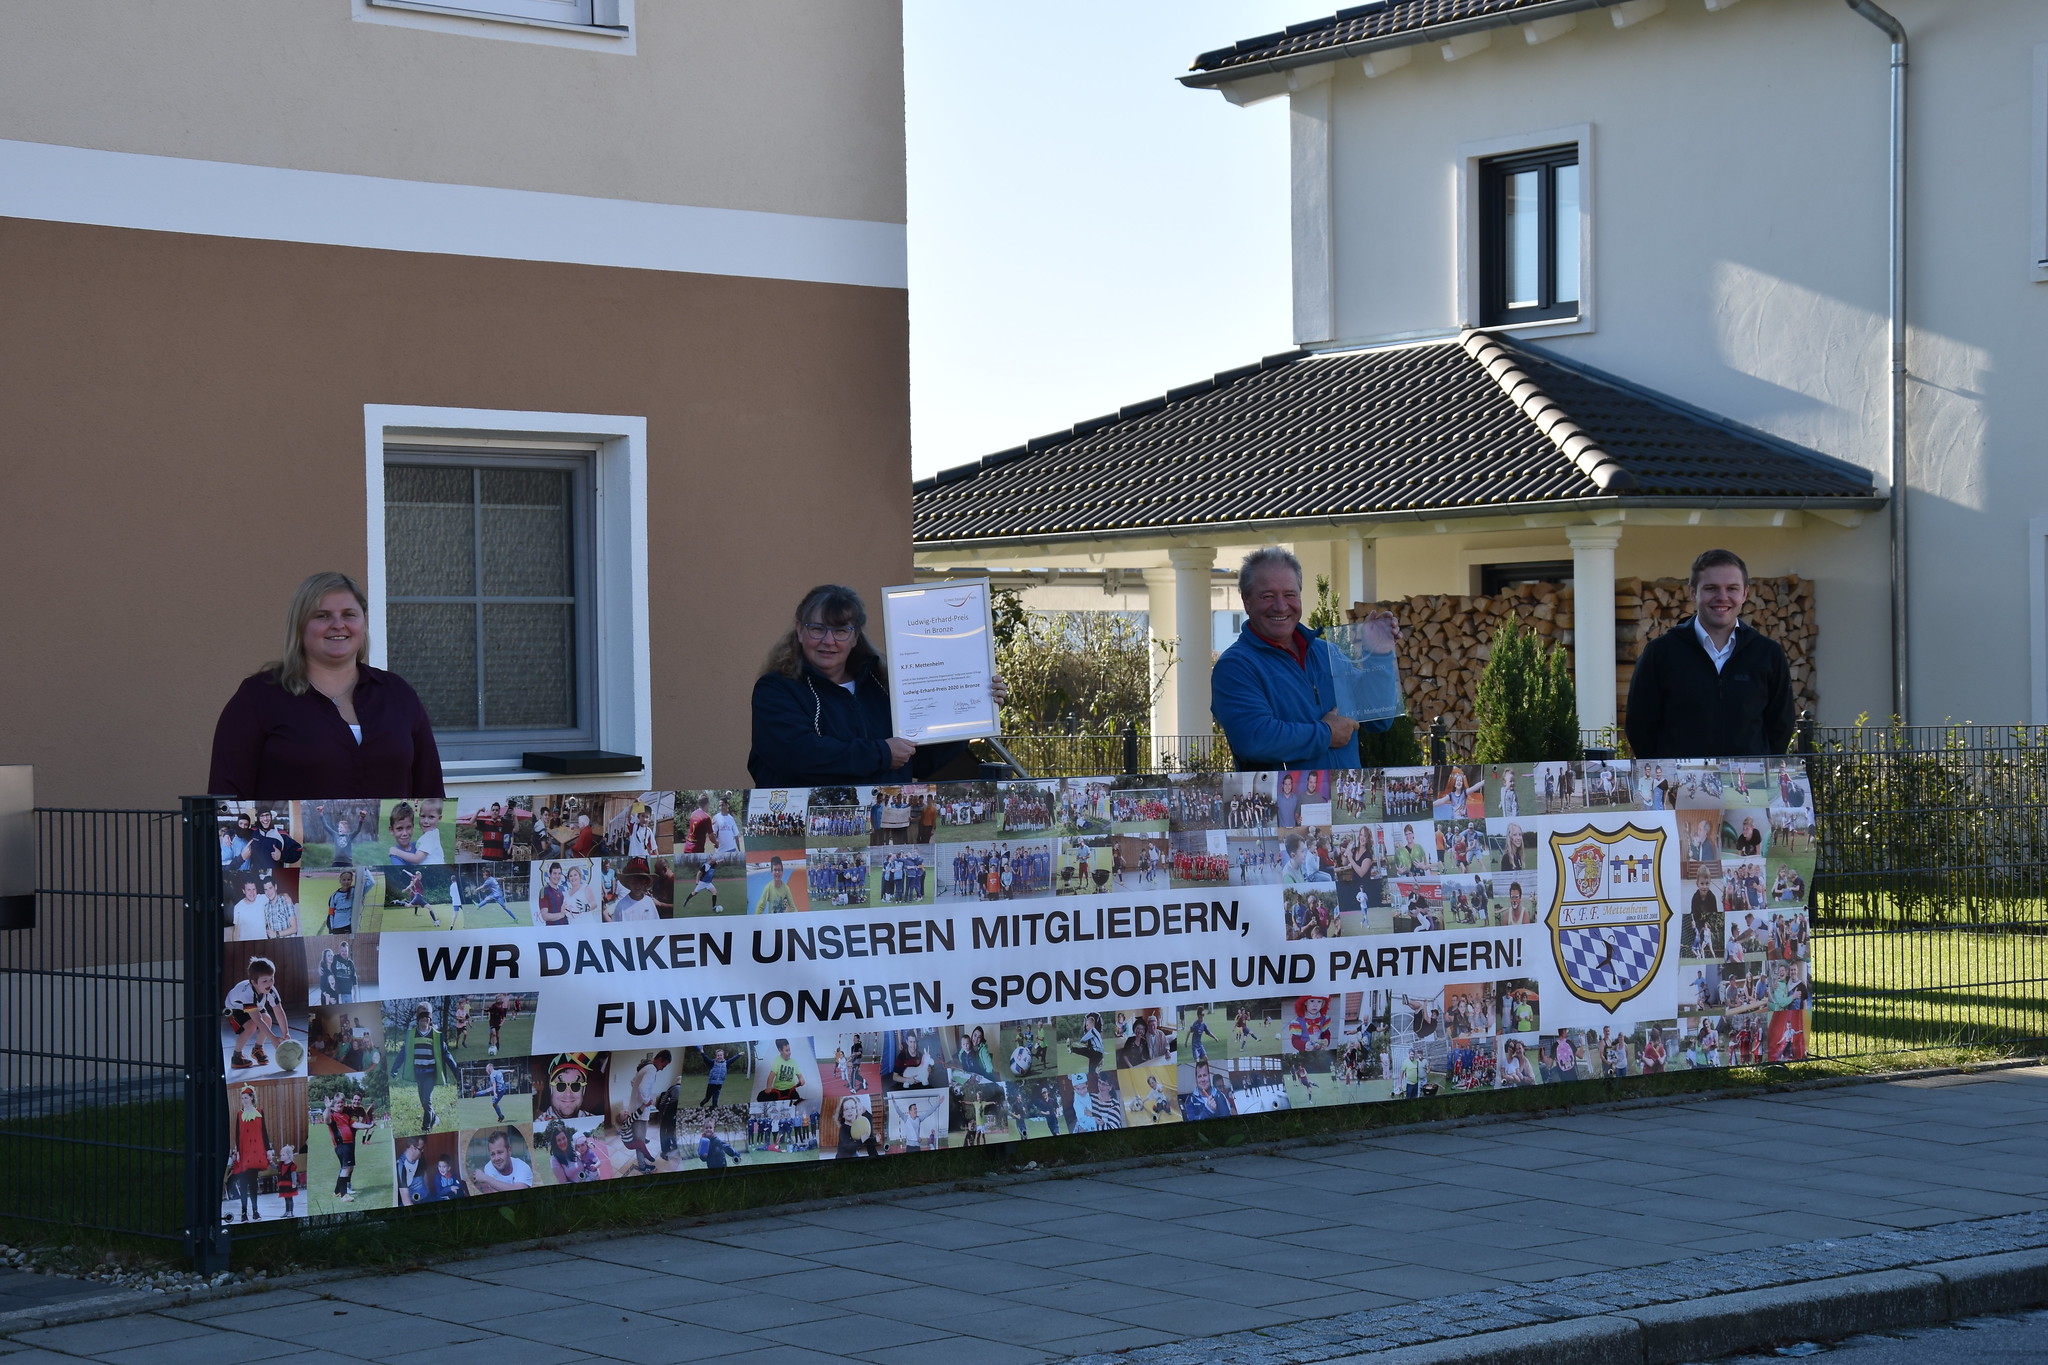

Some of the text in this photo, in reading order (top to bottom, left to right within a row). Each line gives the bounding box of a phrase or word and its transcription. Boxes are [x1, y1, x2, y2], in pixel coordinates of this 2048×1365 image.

[907, 614, 969, 627] Ludwig-Erhard-Preis
[932, 626, 954, 634] Bronze
[915, 661, 945, 669] Mettenheim
[902, 686, 948, 696] Ludwig-Erhard-Preis
[1603, 902, 1649, 916] Mettenheim
[418, 900, 1250, 983] WIR DANKEN UNSEREN MITGLIEDERN,
[594, 936, 1523, 1039] FUNKTIONÄREN, SPONSOREN UND PARTNERN!
